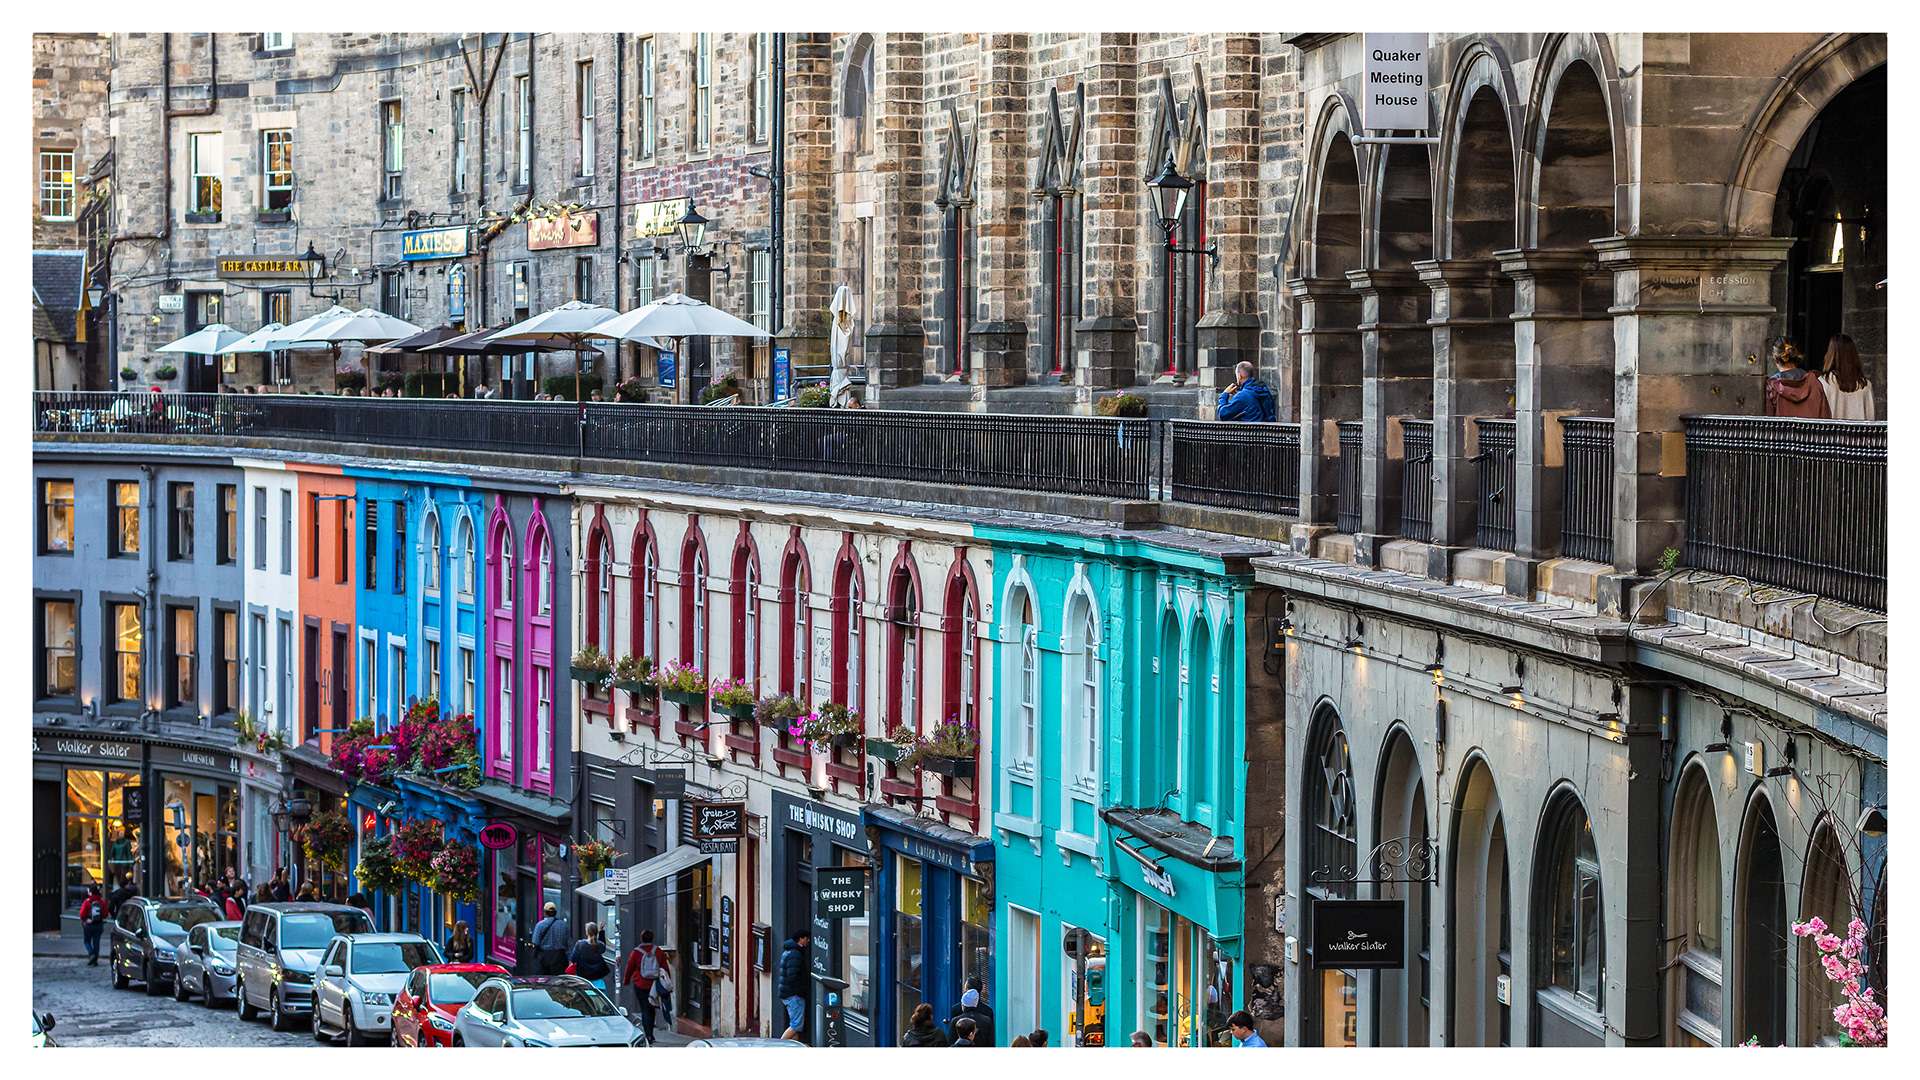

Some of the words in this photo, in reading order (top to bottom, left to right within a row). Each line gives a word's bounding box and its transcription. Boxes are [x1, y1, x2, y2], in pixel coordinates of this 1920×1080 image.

[1372, 49, 1421, 62] Quaker
[1370, 71, 1423, 87] Meeting
[1375, 93, 1418, 106] House
[221, 261, 240, 272] THE
[244, 261, 282, 272] CASTLE
[1653, 276, 1699, 285] ORIGINAL
[1704, 276, 1756, 285] SECESSION
[321, 668, 333, 706] 40
[57, 740, 94, 754] Walker
[99, 742, 130, 757] Slater
[182, 752, 215, 767] LADIESWEAR
[789, 804, 804, 823] THE
[805, 806, 835, 833] WHISKY
[836, 818, 857, 840] SHOP
[700, 841, 738, 854] RESTAURANT
[831, 877, 852, 885] THE
[821, 889, 863, 900] WHISKY
[827, 904, 855, 912] SHOP
[1328, 941, 1360, 951] Walker
[1361, 940, 1388, 951] Slater
[828, 992, 836, 1006] P
